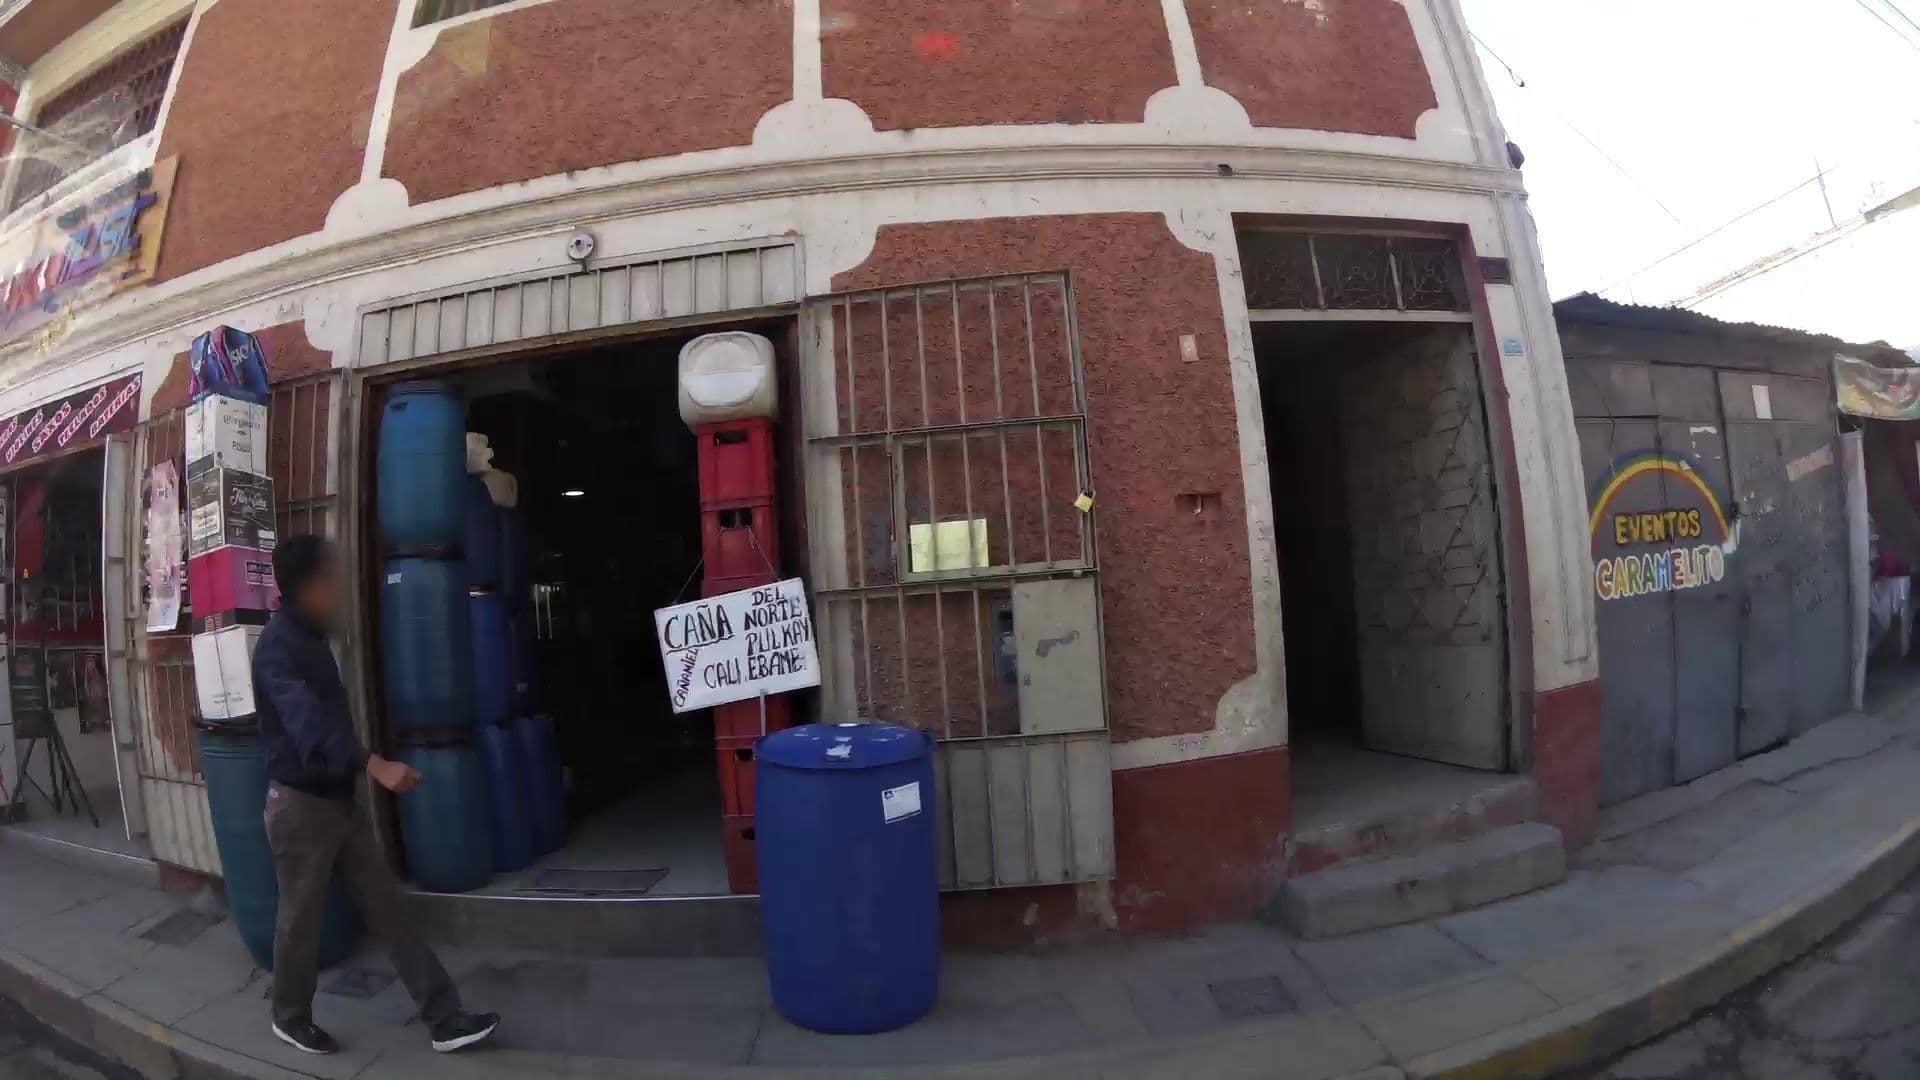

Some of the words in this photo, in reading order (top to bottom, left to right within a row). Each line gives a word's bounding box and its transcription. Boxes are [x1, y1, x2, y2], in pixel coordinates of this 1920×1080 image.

[32, 401, 71, 453] SAXOS
[1614, 510, 1701, 545] EVENTOS
[1596, 544, 1725, 600] CARAMELITO
[744, 597, 802, 631] NORTE
[752, 586, 784, 606] DEL
[664, 604, 733, 649] CAÑA
[673, 649, 700, 708] CAÑAMIEL
